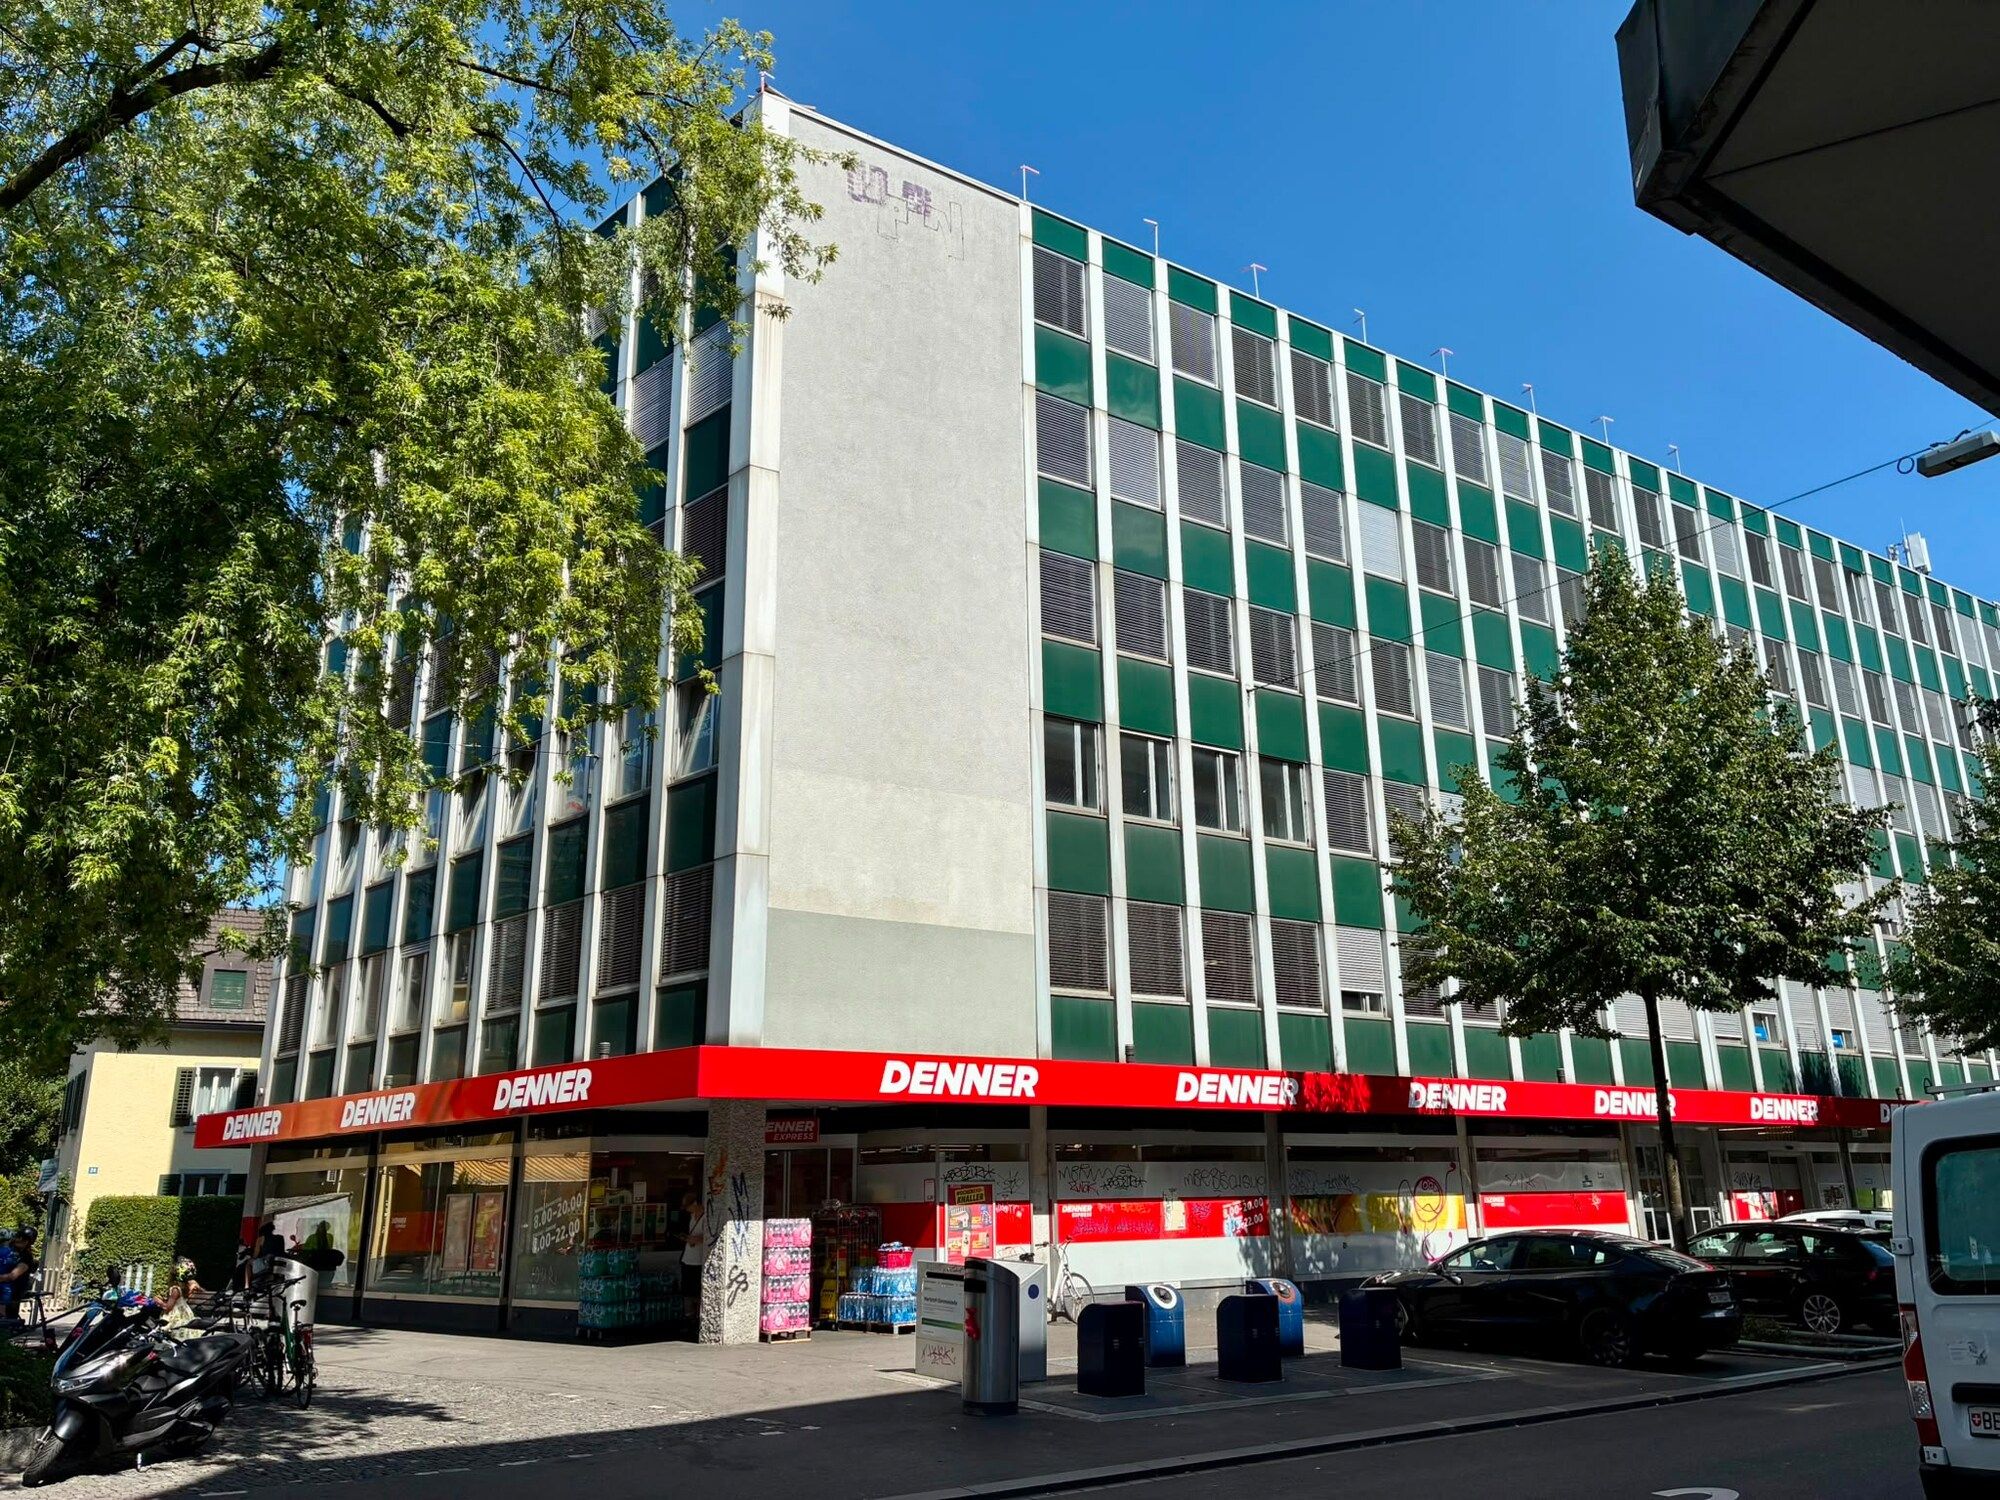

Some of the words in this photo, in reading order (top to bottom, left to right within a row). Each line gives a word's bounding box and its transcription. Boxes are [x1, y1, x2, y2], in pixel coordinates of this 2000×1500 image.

[493, 1068, 593, 1111] DENNER
[879, 1060, 1040, 1098] DENNER
[1175, 1072, 1298, 1105] DENNER
[340, 1092, 416, 1129] DENNER
[1408, 1082, 1507, 1112] DENNER
[1750, 1096, 1819, 1122] DENNER
[222, 1110, 283, 1141] DENNER
[766, 1120, 815, 1132] ENNER
[773, 1132, 815, 1141] EXPRESS
[532, 1192, 582, 1230] 8.00-20.00
